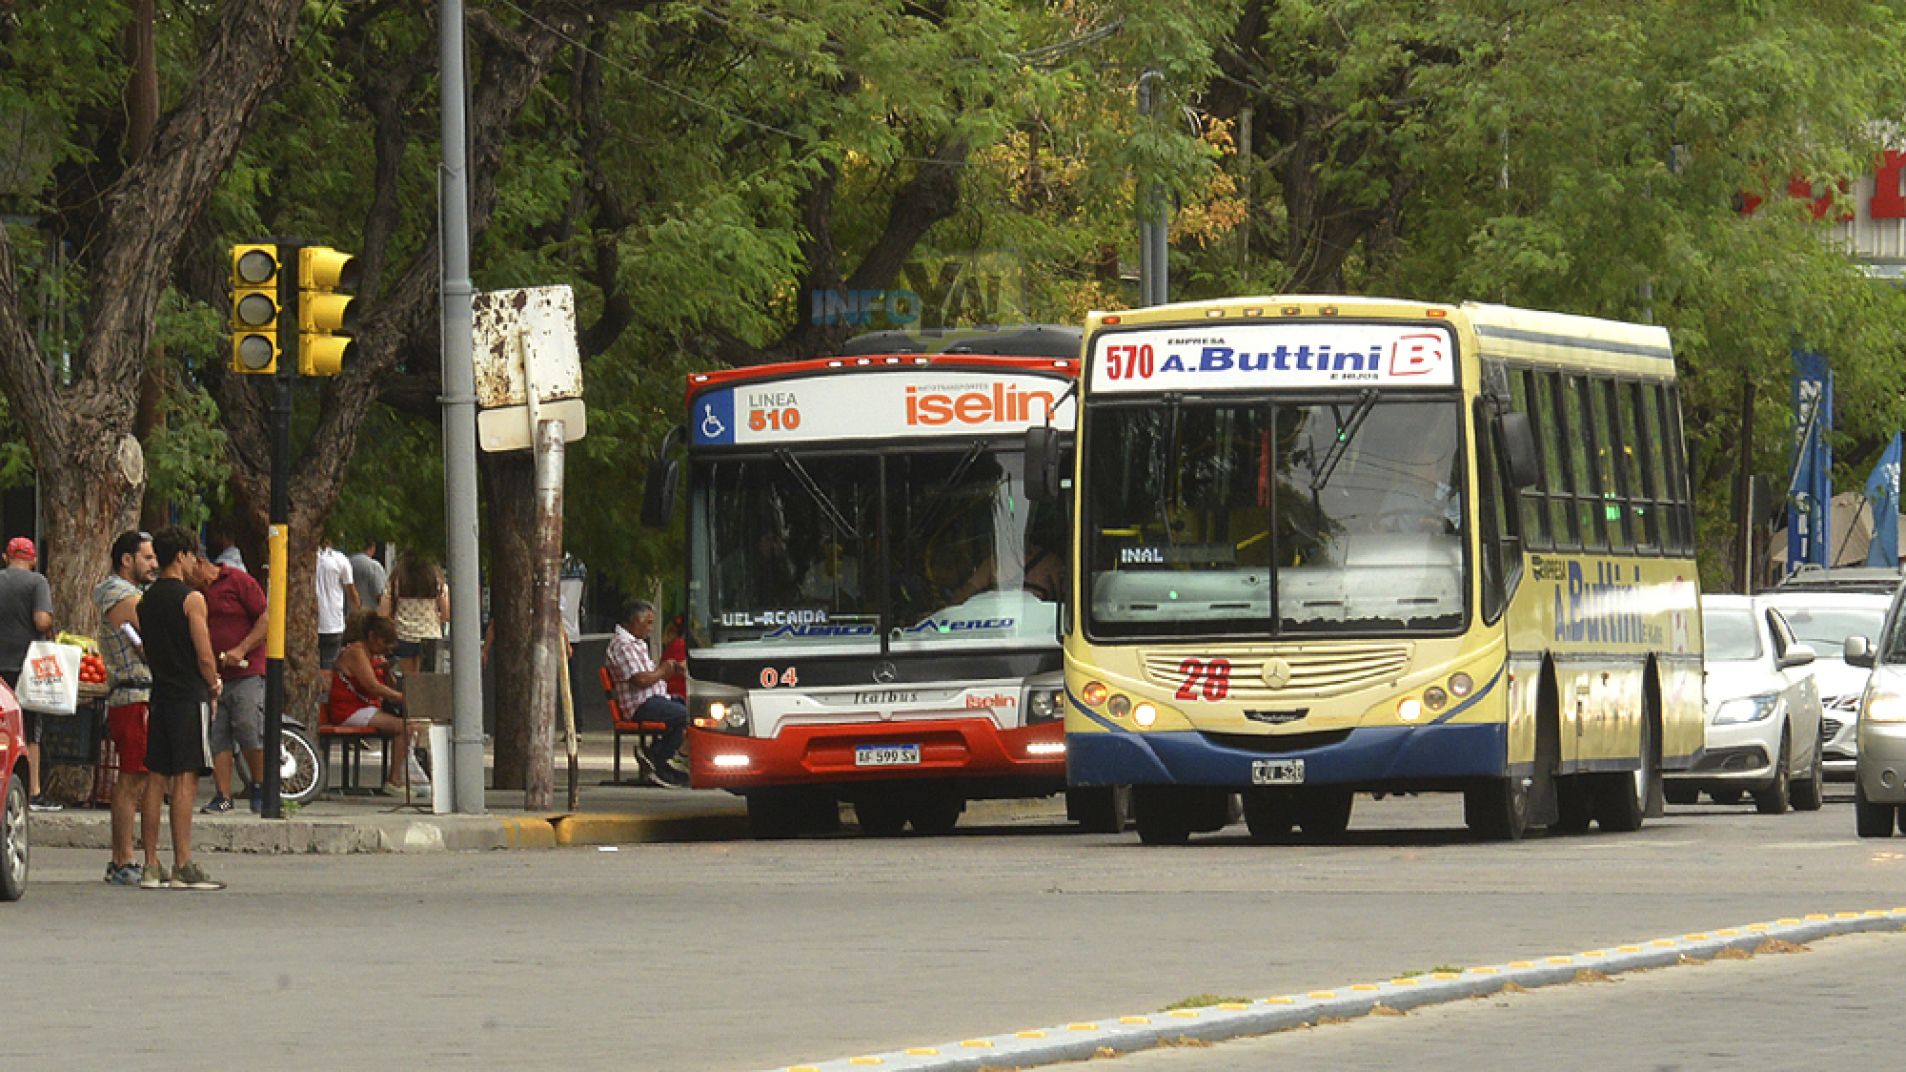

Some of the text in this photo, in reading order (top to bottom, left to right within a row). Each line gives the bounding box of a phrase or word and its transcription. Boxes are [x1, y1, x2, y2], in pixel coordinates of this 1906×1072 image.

[1106, 344, 1154, 381] 570
[749, 392, 798, 407] LINEA
[748, 407, 801, 431] 510
[1121, 547, 1164, 563] INAL
[760, 667, 799, 688] 04
[1174, 657, 1231, 702] 28
[876, 750, 898, 762] 599
